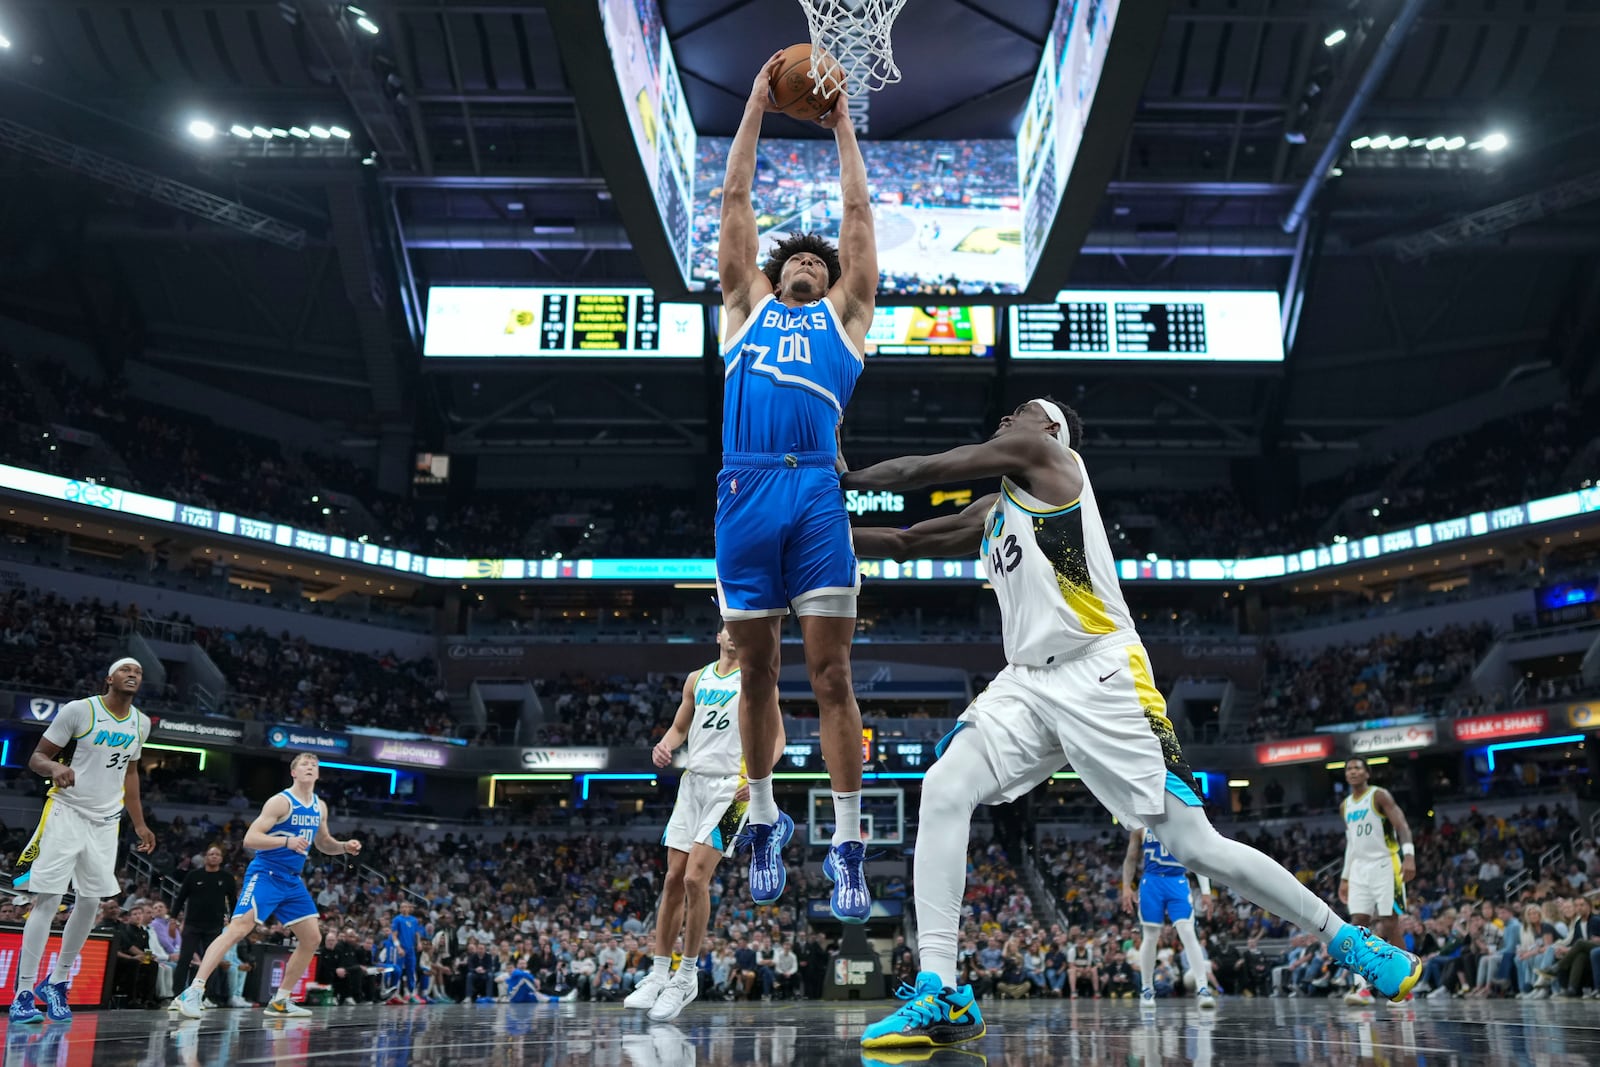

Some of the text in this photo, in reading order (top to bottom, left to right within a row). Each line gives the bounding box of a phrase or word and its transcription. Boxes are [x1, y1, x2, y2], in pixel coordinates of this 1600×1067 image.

[762, 310, 828, 331] BUCKS
[777, 332, 812, 364] 00
[845, 489, 904, 516] Spirits
[992, 534, 1022, 578] 43
[943, 561, 962, 577] 91
[695, 688, 738, 707] INDY
[159, 719, 195, 733] Fanatics
[702, 710, 730, 730] 26
[1456, 720, 1494, 736] STEAK
[1504, 714, 1545, 730] SHAKE
[93, 729, 136, 750] INDY
[290, 734, 316, 746] Sports
[316, 736, 334, 747] Tech
[1352, 732, 1405, 750] KeyBank
[106, 752, 131, 770] 33
[791, 755, 921, 767] 93 91
[291, 814, 320, 827] BUCKS
[1357, 823, 1373, 837] 00
